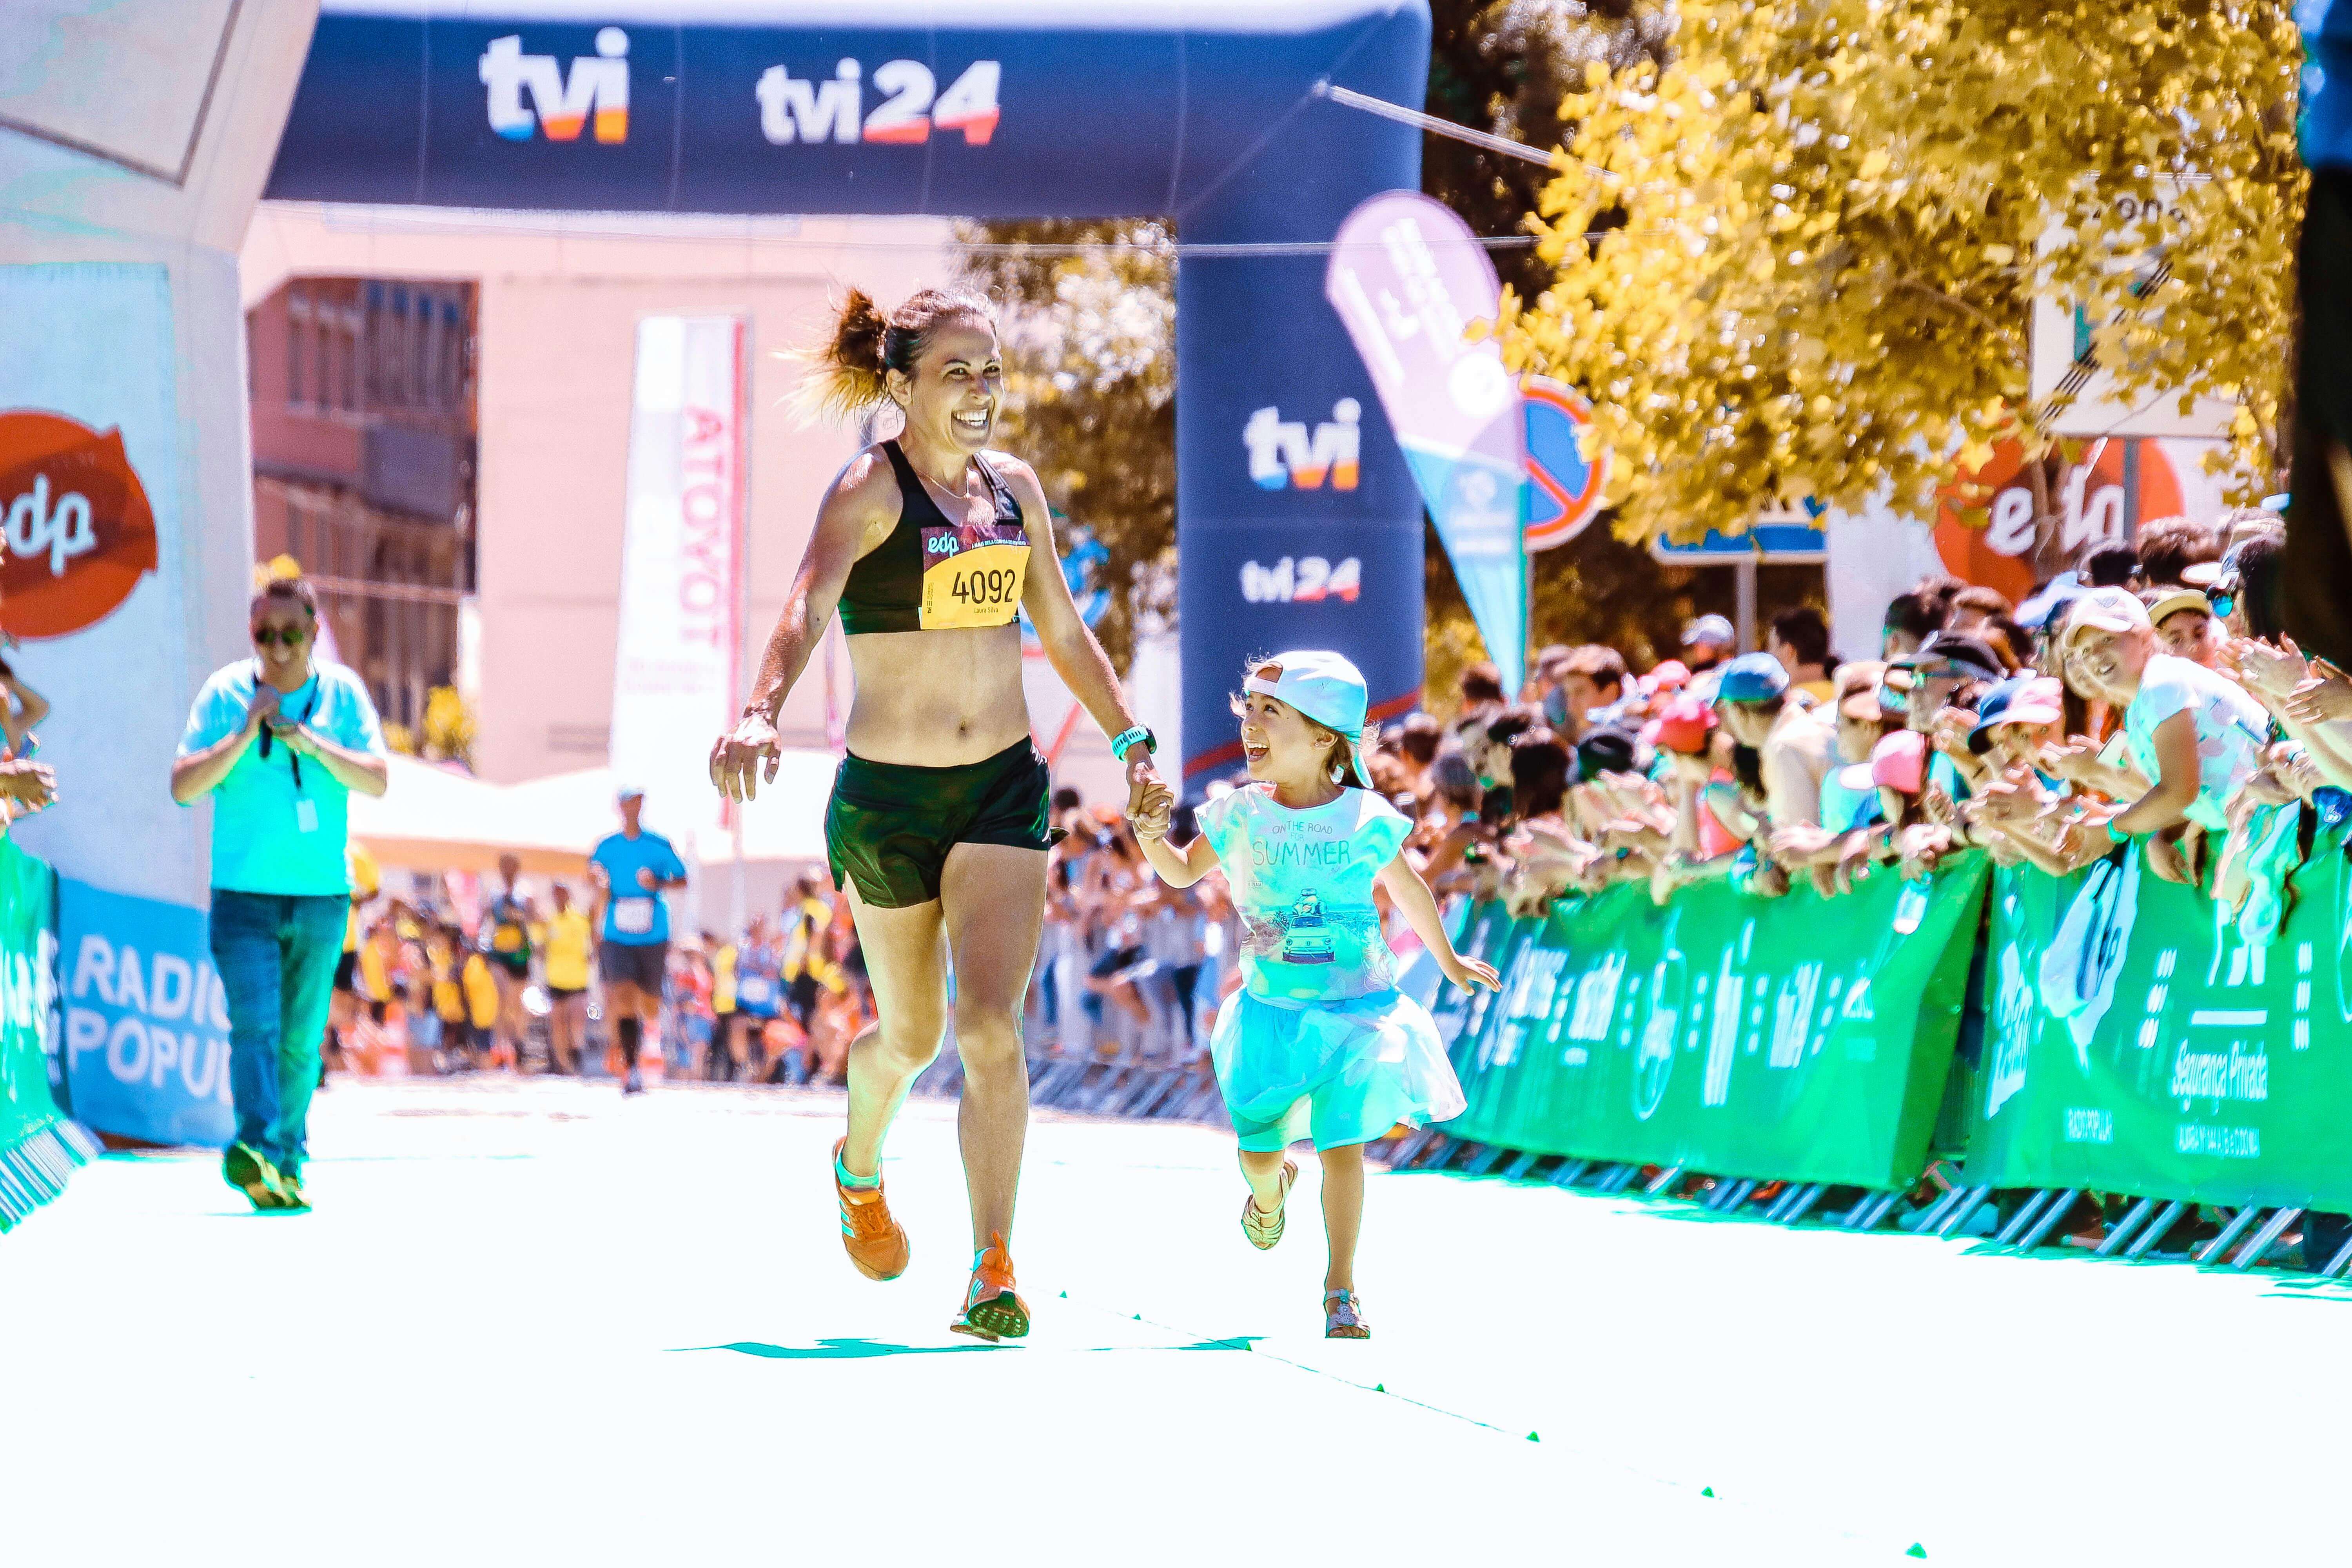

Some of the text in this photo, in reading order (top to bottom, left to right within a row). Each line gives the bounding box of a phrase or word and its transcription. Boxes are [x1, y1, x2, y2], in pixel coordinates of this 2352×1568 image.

[479, 26, 629, 143] tvi
[756, 57, 1002, 145] tvi24
[1243, 397, 1362, 492] tvi
[0, 472, 97, 577] dp
[928, 531, 959, 557] edp
[952, 569, 1016, 604] 4092
[1240, 556, 1362, 603] tvi24
[1253, 840, 1350, 866] SUMMER
[1272, 820, 1333, 834] ON THE ROAD
[2172, 1038, 2229, 1113] Segurança
